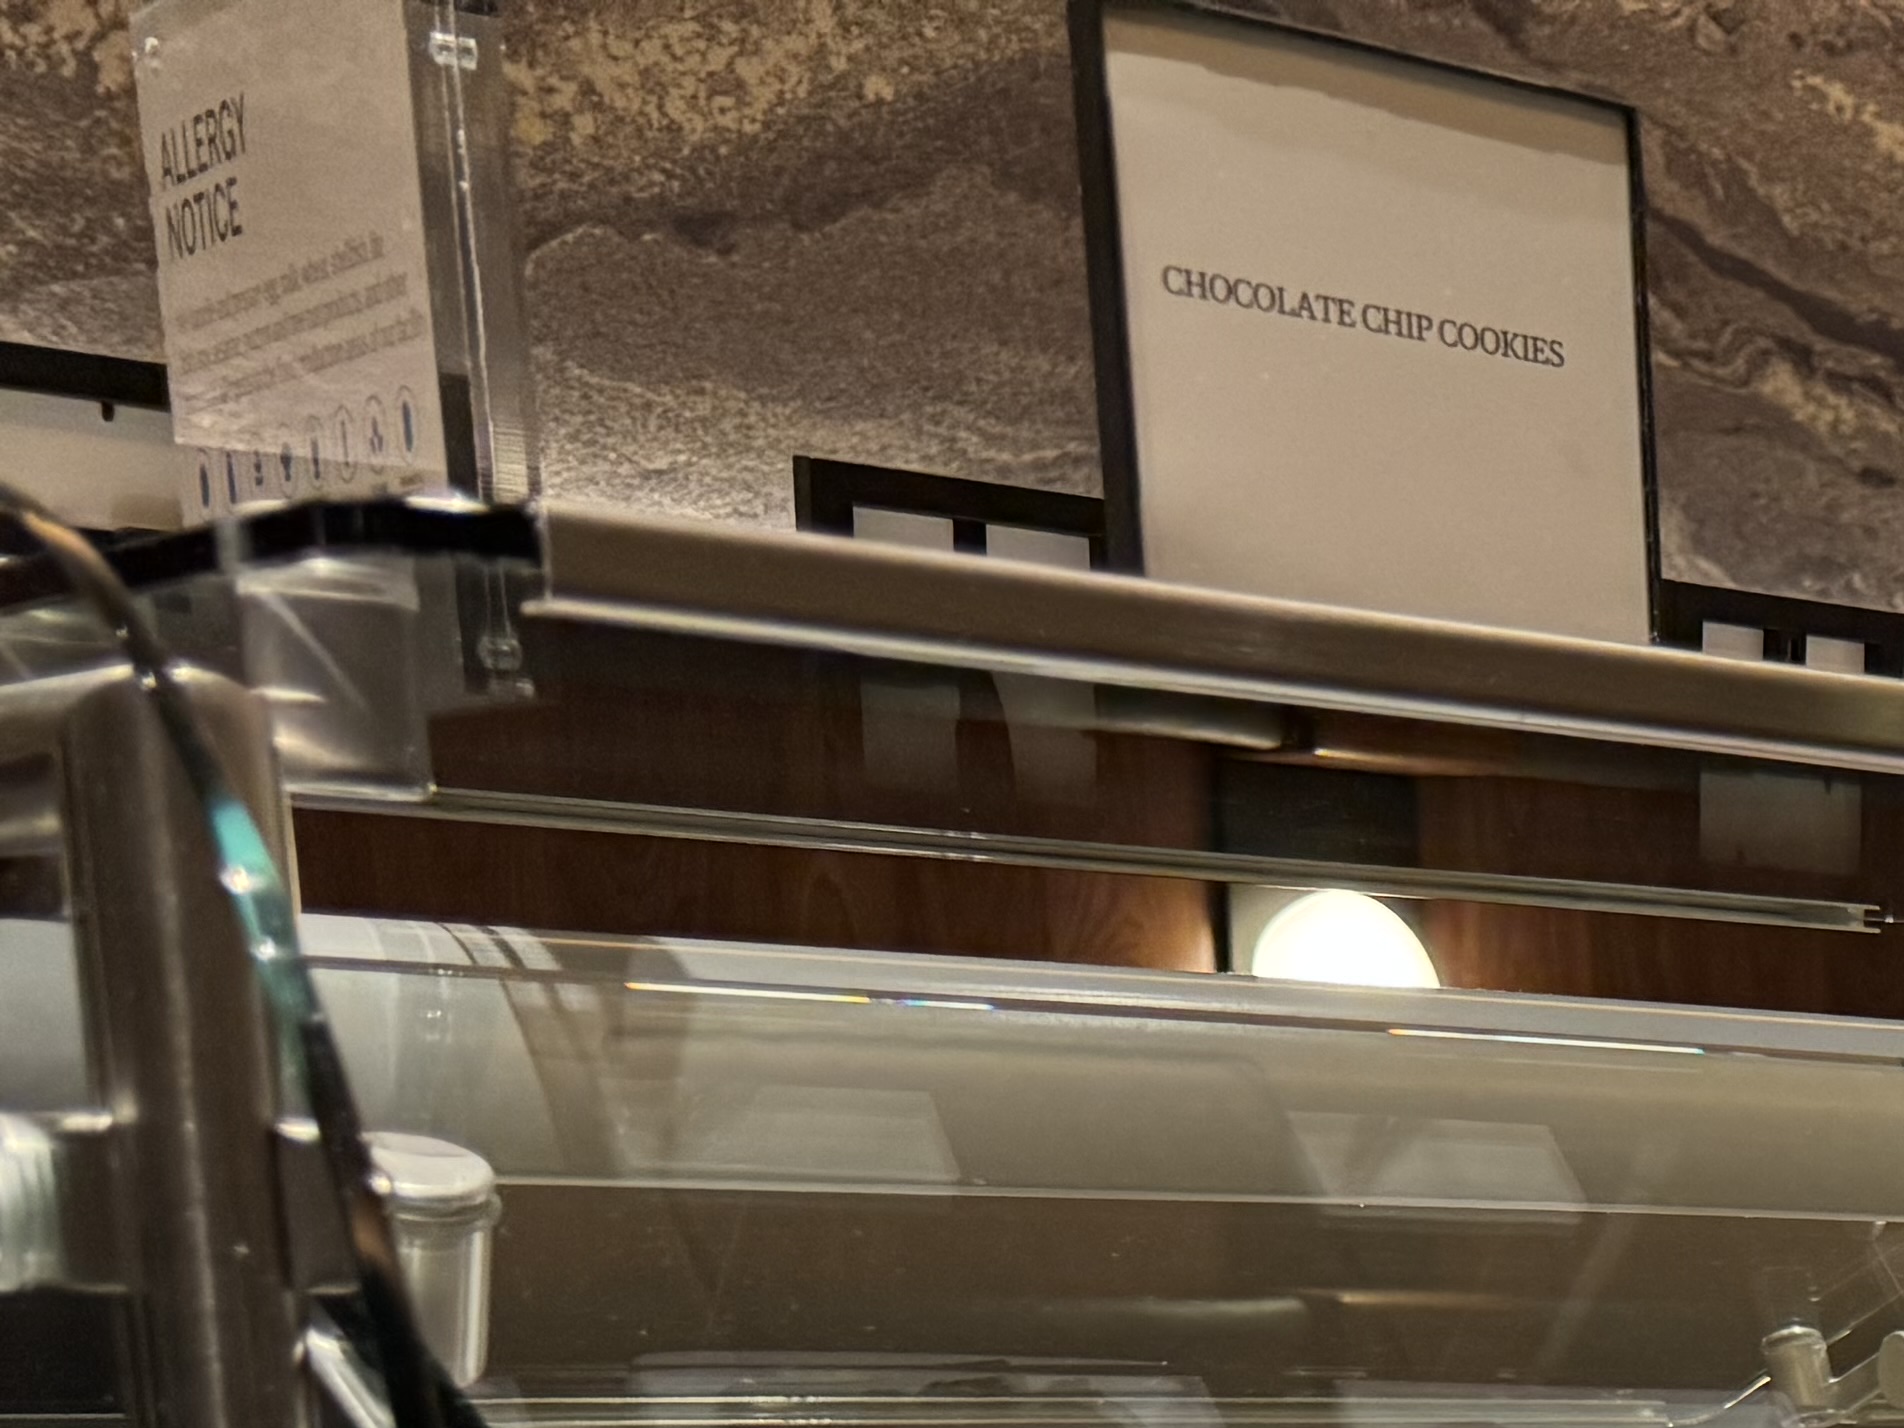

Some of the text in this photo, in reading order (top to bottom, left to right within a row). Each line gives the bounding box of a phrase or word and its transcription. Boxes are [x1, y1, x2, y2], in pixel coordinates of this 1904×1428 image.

[160, 92, 247, 188] ALLERGY
[166, 177, 244, 260] NOTICE
[1161, 263, 1567, 369] CHOCOLATE CHIP COOKIES
